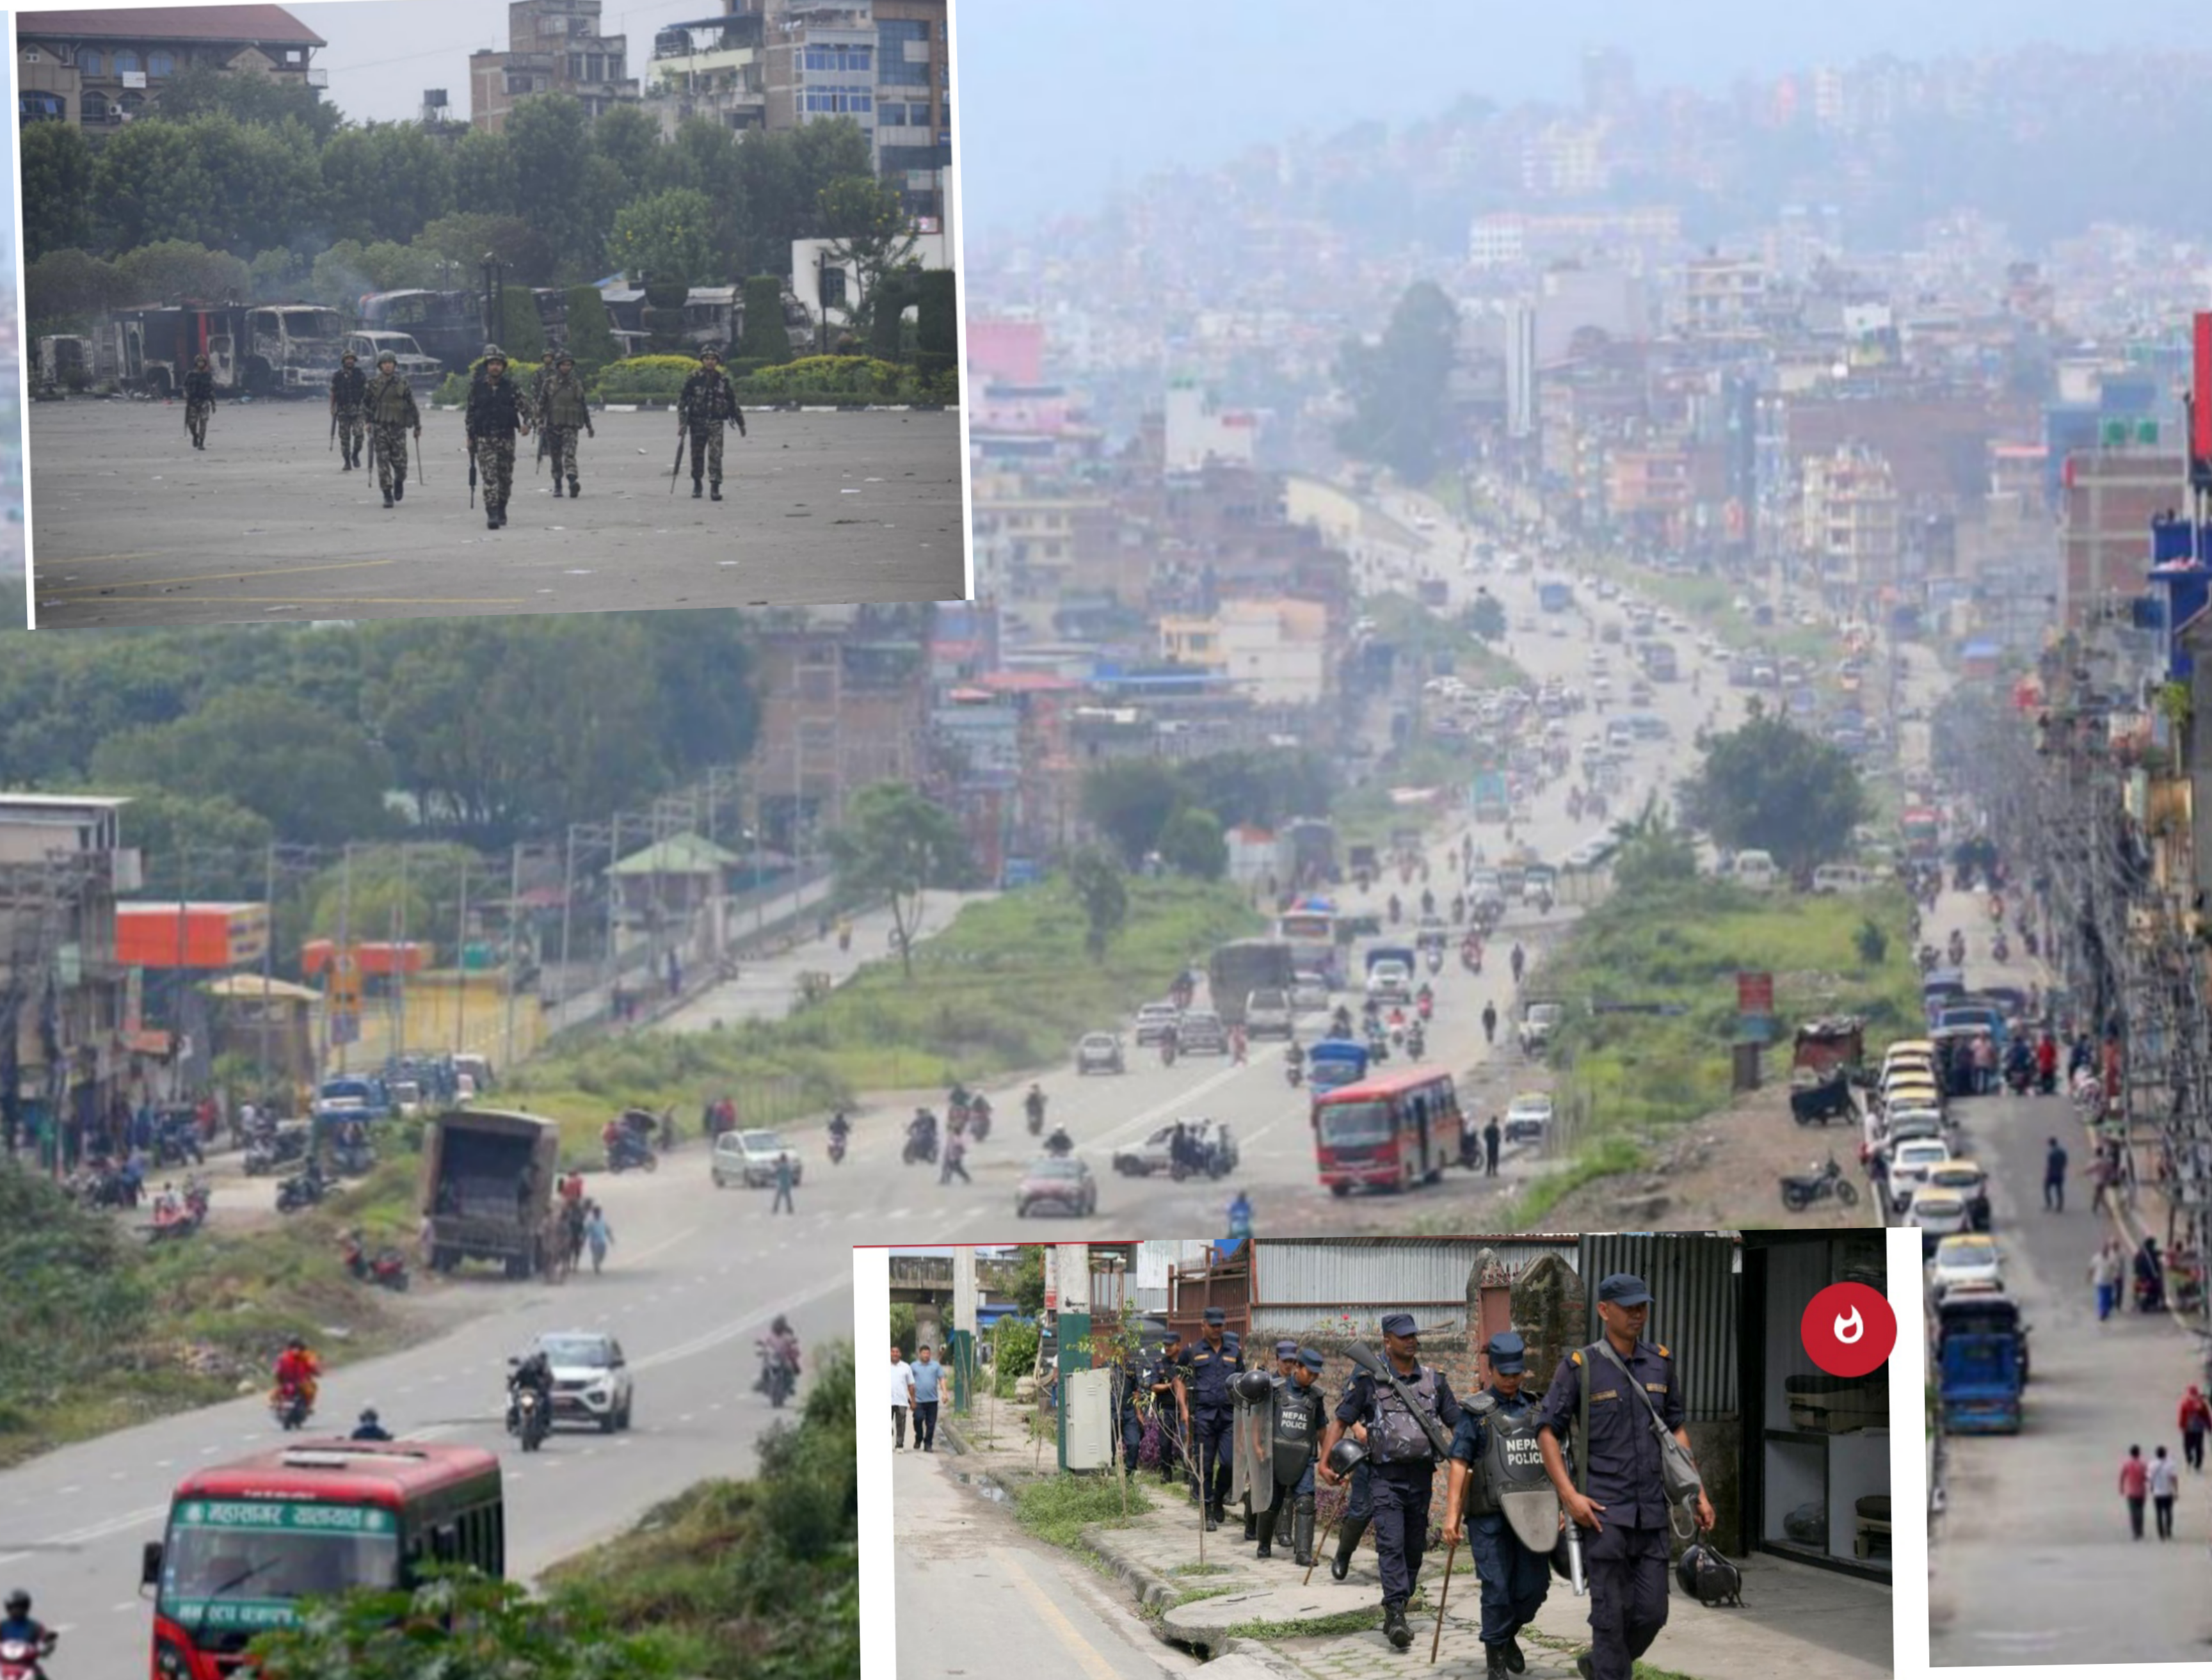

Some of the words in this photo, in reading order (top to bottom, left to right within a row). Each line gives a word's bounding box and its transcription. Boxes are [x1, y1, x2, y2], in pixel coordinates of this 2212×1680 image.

[1282, 1411, 1307, 1421] NEPAL
[1281, 1420, 1306, 1430] POLICE
[1506, 1438, 1538, 1452] NEPA
